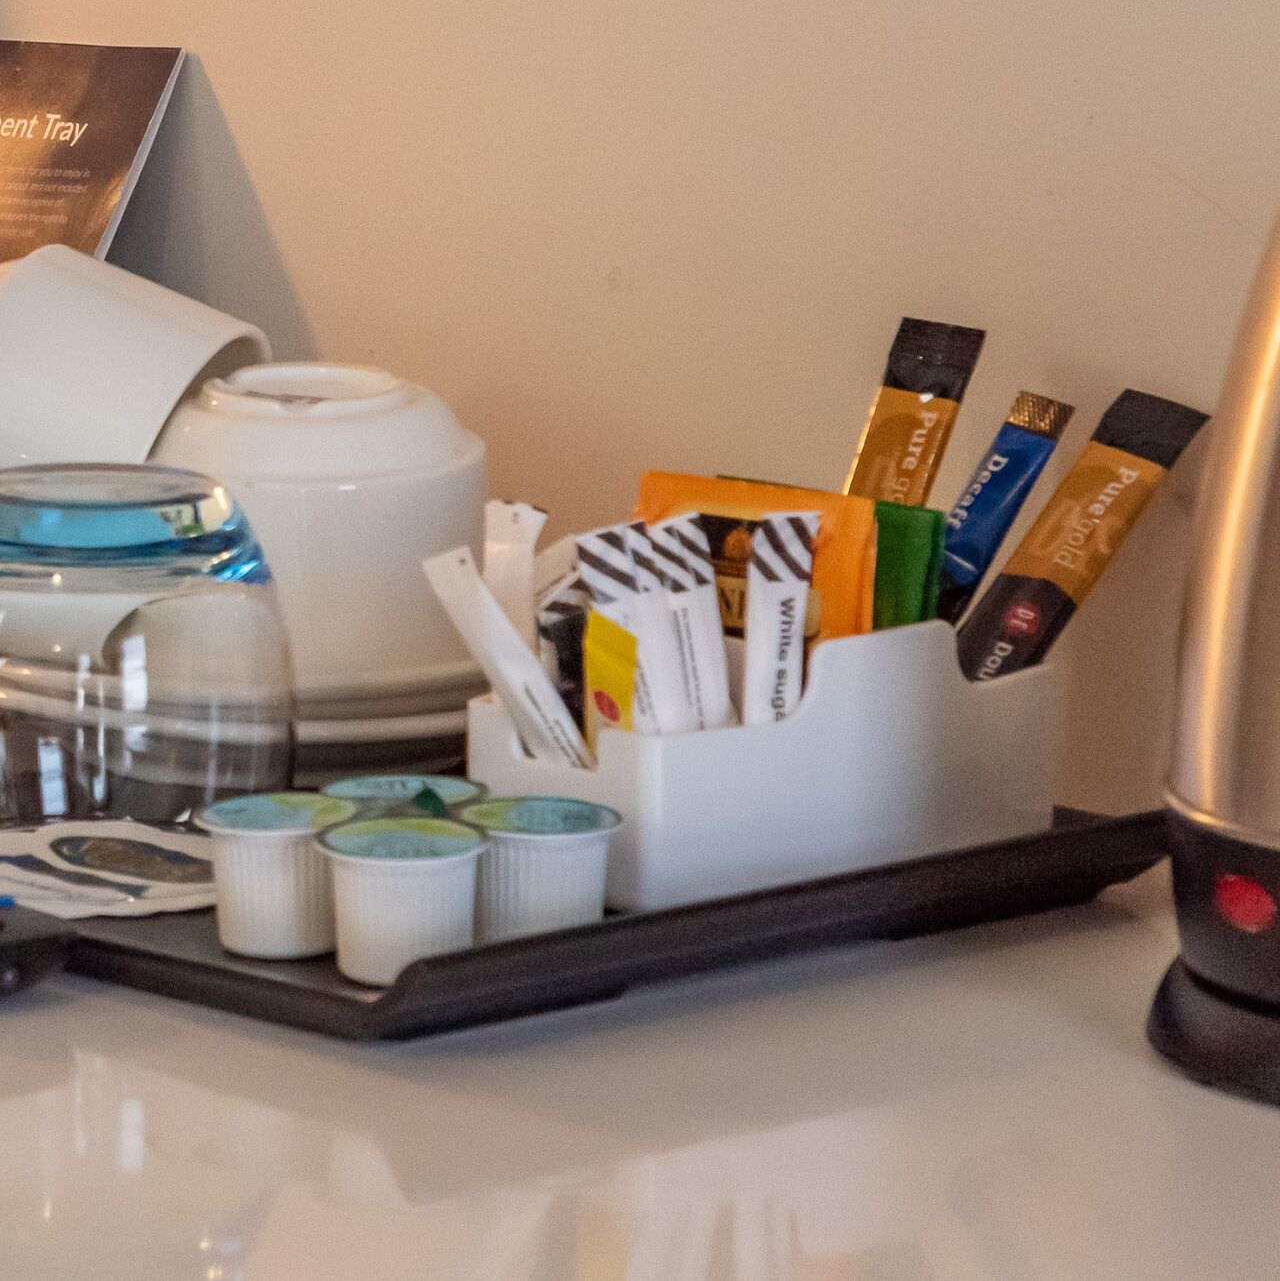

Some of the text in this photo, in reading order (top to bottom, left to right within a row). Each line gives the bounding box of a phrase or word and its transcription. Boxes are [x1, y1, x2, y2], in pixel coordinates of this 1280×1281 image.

[43, 113, 89, 147] Tray
[902, 410, 939, 471] Pure
[946, 453, 1010, 530] Decaff
[1054, 466, 1140, 569] Pure gold
[771, 596, 796, 722] White suga
[977, 640, 1014, 681] Dou
